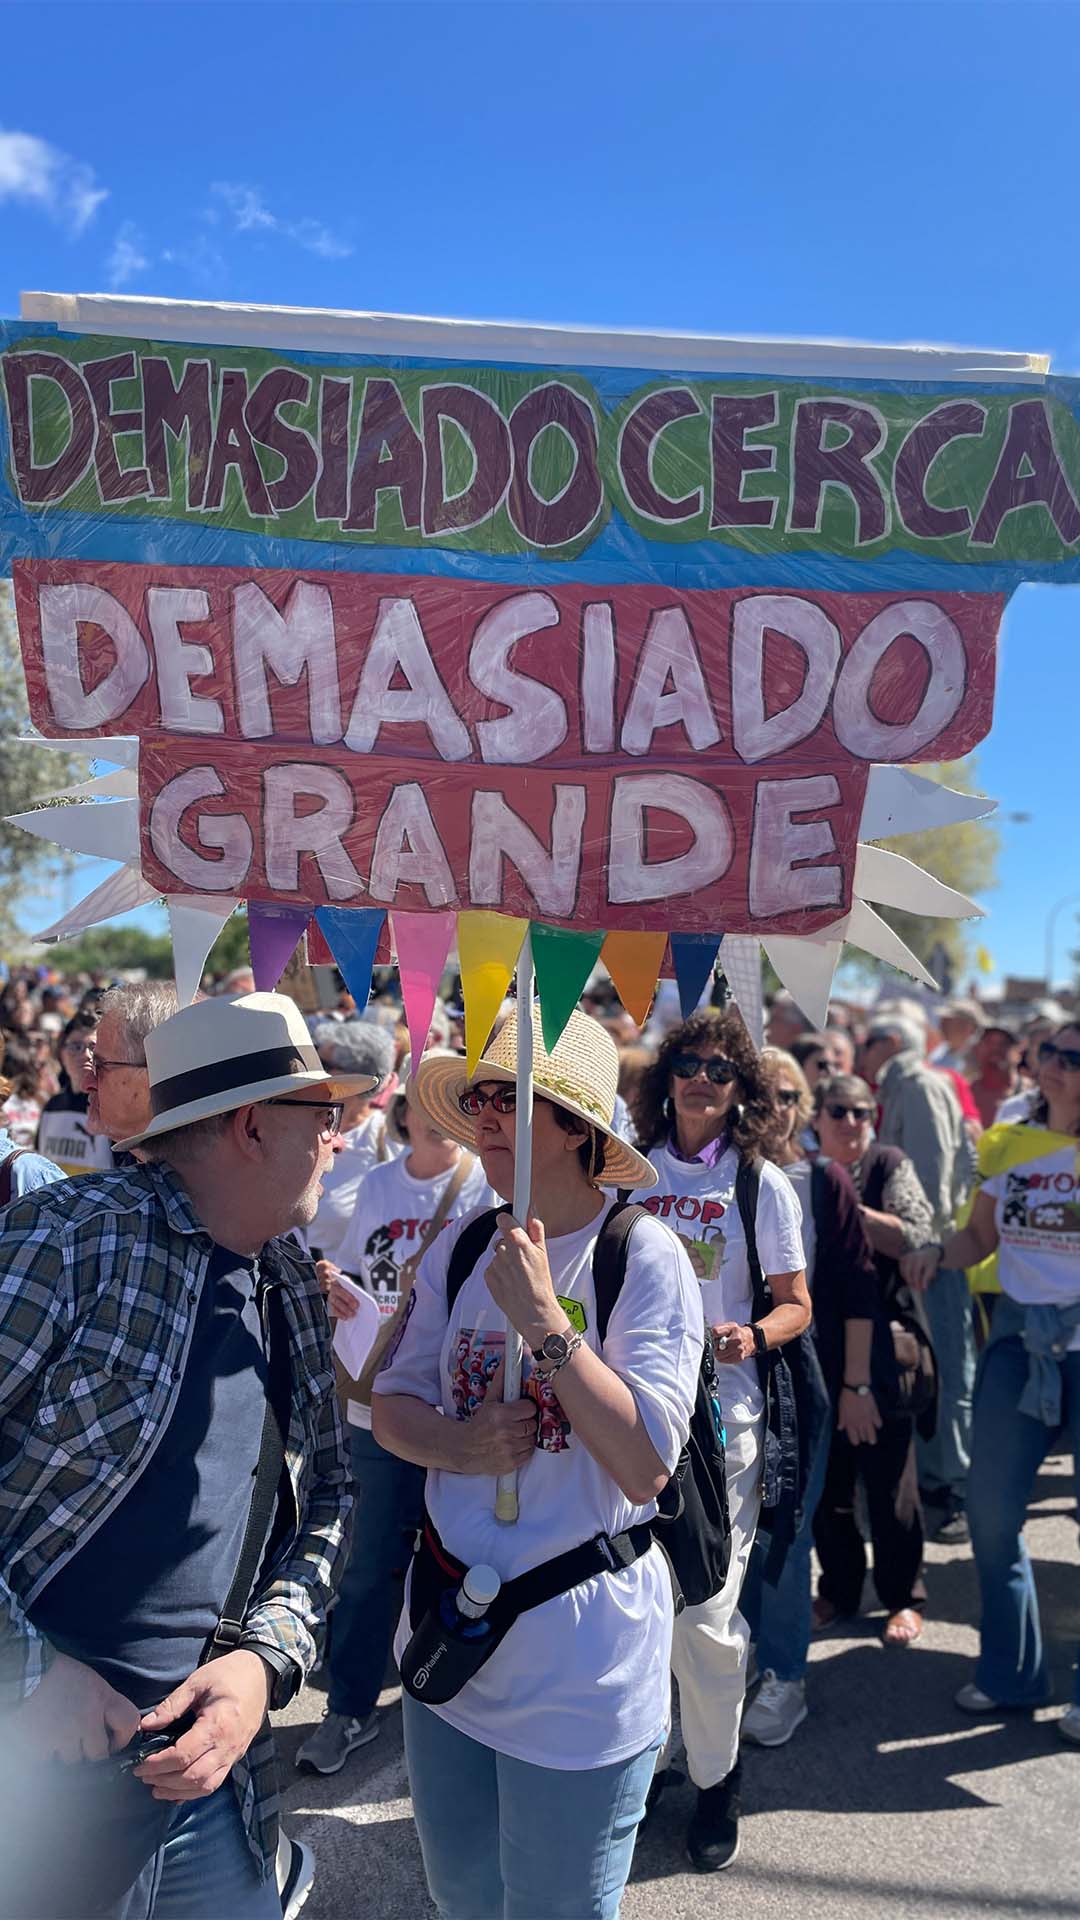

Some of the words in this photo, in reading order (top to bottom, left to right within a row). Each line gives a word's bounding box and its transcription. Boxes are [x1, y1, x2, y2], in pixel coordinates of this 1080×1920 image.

[3, 350, 604, 550] DEMASIADO
[616, 386, 1080, 548] CERCA
[37, 581, 968, 764] DEMASIADO
[151, 763, 845, 918] GRANDE
[643, 1195, 725, 1224] STOP
